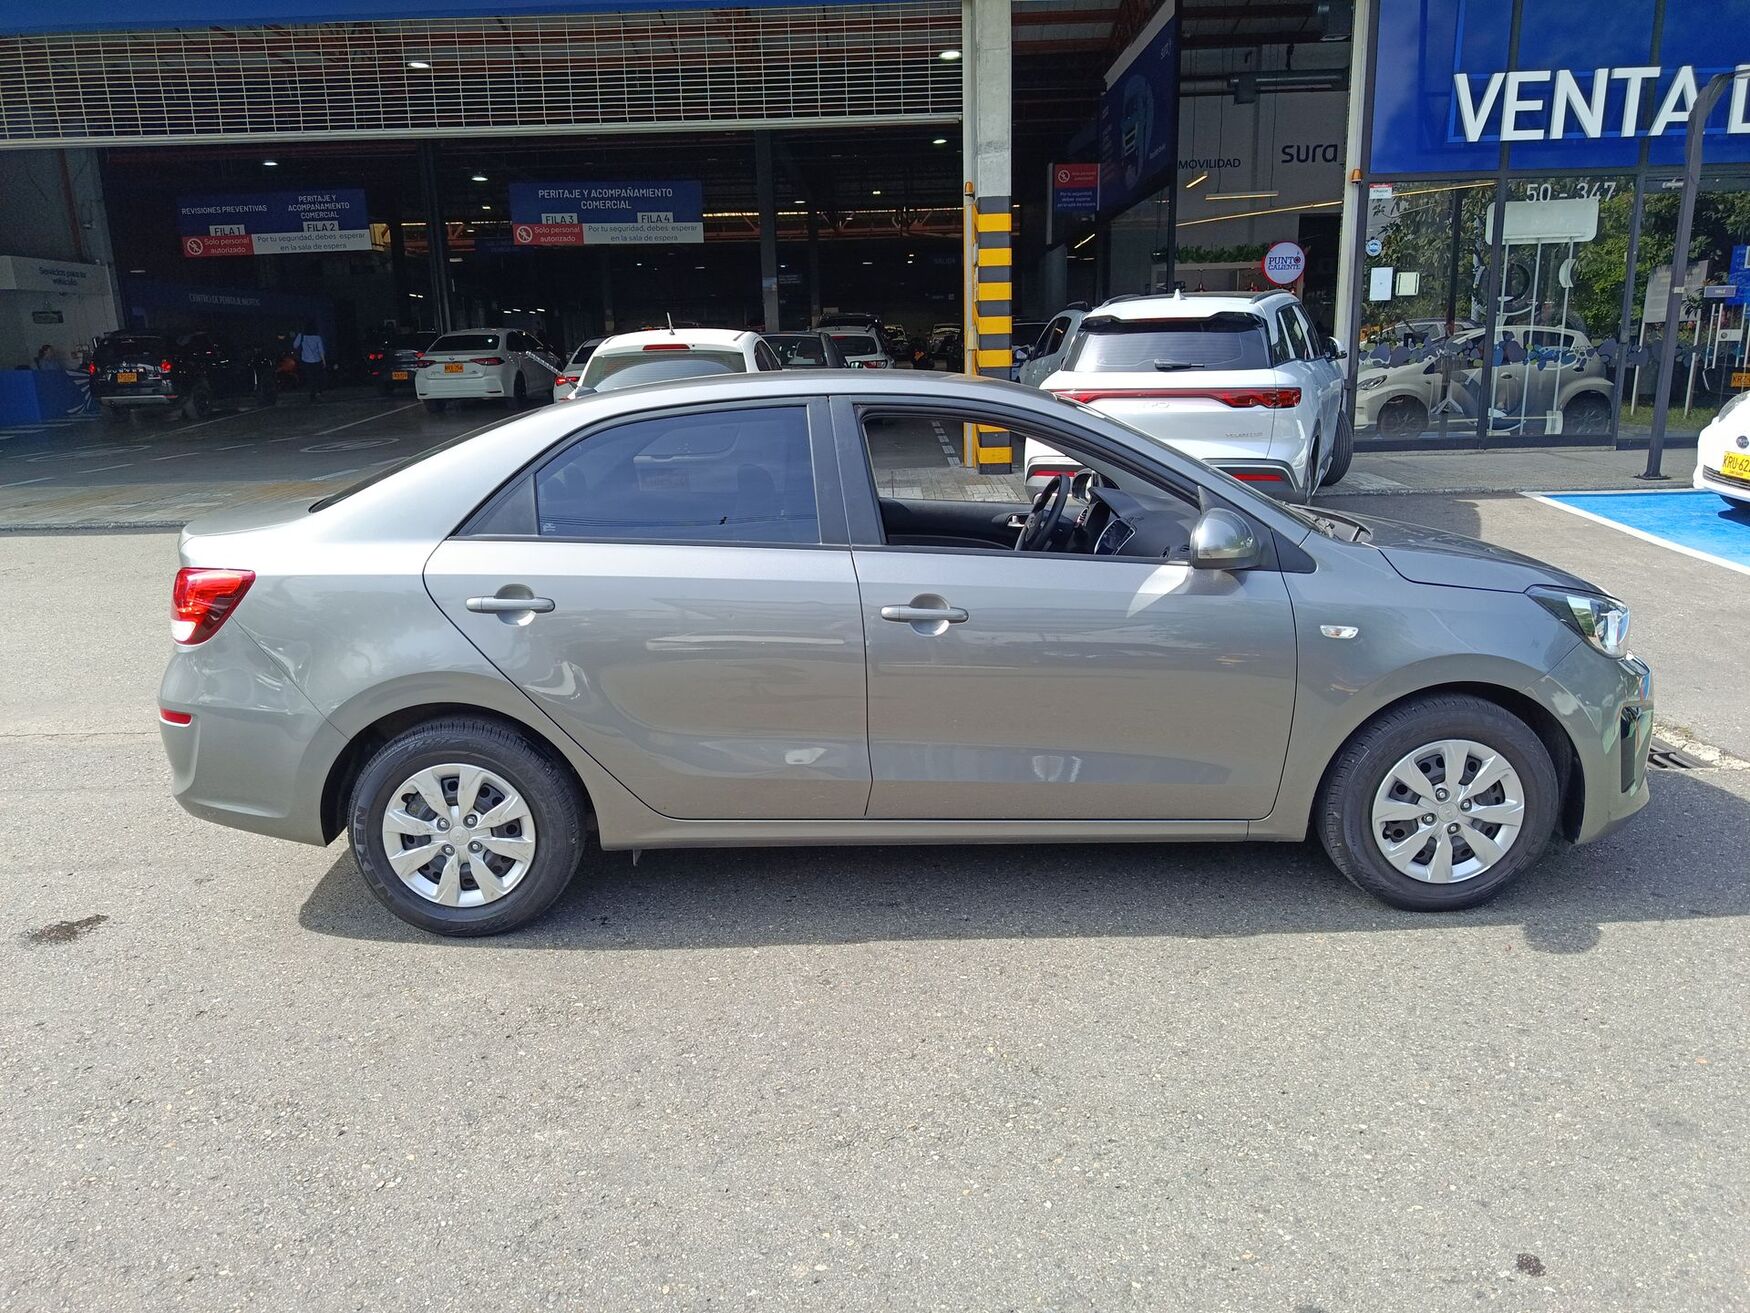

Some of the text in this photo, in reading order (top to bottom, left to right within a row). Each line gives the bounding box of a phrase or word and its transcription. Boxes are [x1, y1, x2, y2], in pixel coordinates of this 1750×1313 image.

[1453, 65, 1698, 143] VENTA
[1281, 143, 1339, 164] sura
[1178, 158, 1241, 169] MOVILIDAD
[538, 186, 673, 199] PERITAJE Y ACOMPAÑAMIENTO
[1526, 184, 1552, 203] 50
[1575, 182, 1617, 202] 347
[298, 195, 331, 203] PERITAJE
[581, 200, 632, 209] COMERCIAL
[181, 204, 268, 215] REVISIONES PREVENTIVAS
[300, 211, 340, 219] COMERCIAL
[545, 215, 574, 224] FILA 3
[641, 214, 670, 223] FILA 4
[214, 227, 235, 236] FILA
[307, 222, 336, 232] FILA 2
[550, 226, 580, 235] personal
[1268, 256, 1301, 265] PUNTO
